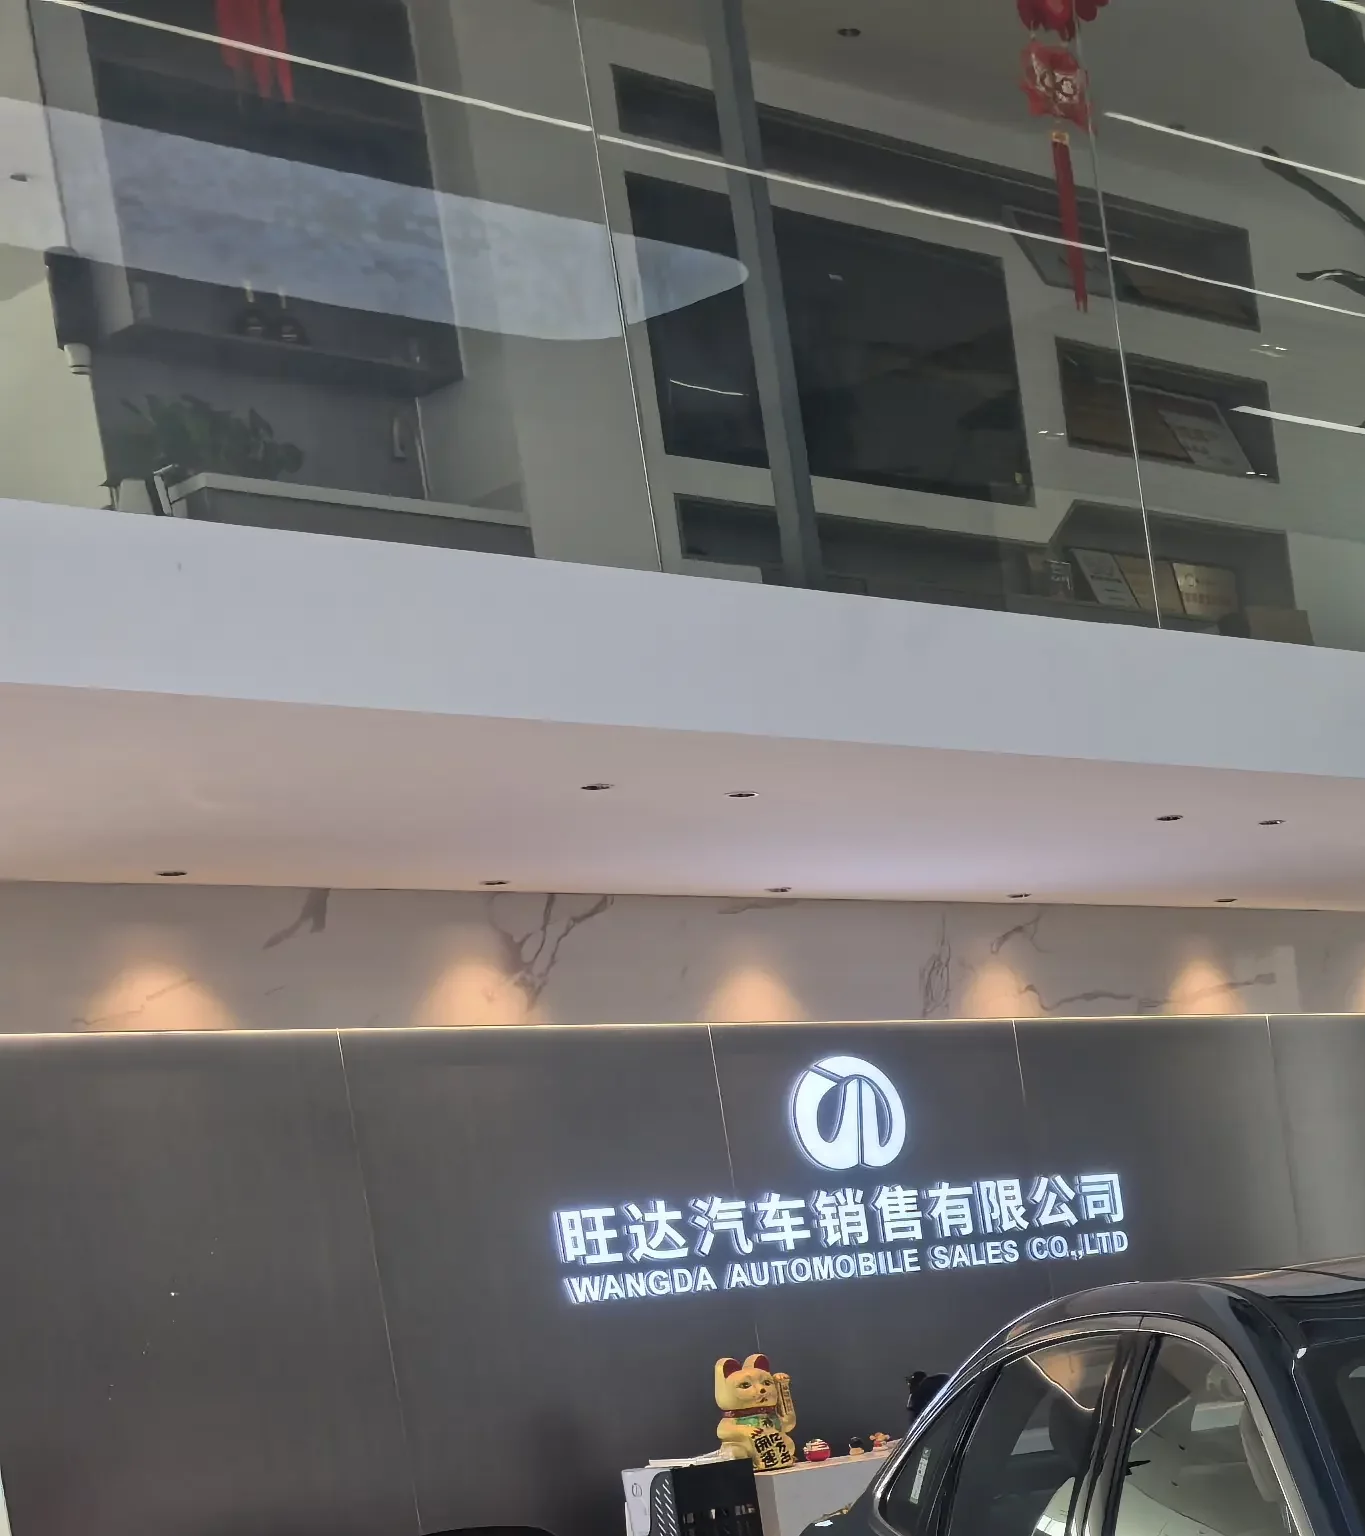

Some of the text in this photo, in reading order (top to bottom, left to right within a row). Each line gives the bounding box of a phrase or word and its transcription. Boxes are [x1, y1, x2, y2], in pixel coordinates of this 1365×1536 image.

[554, 1173, 1125, 1264] 旺达汽车销售有限公司
[565, 1266, 717, 1304] WANGDA
[726, 1249, 921, 1290] AUTOMOBILE
[929, 1239, 1020, 1270] SALES
